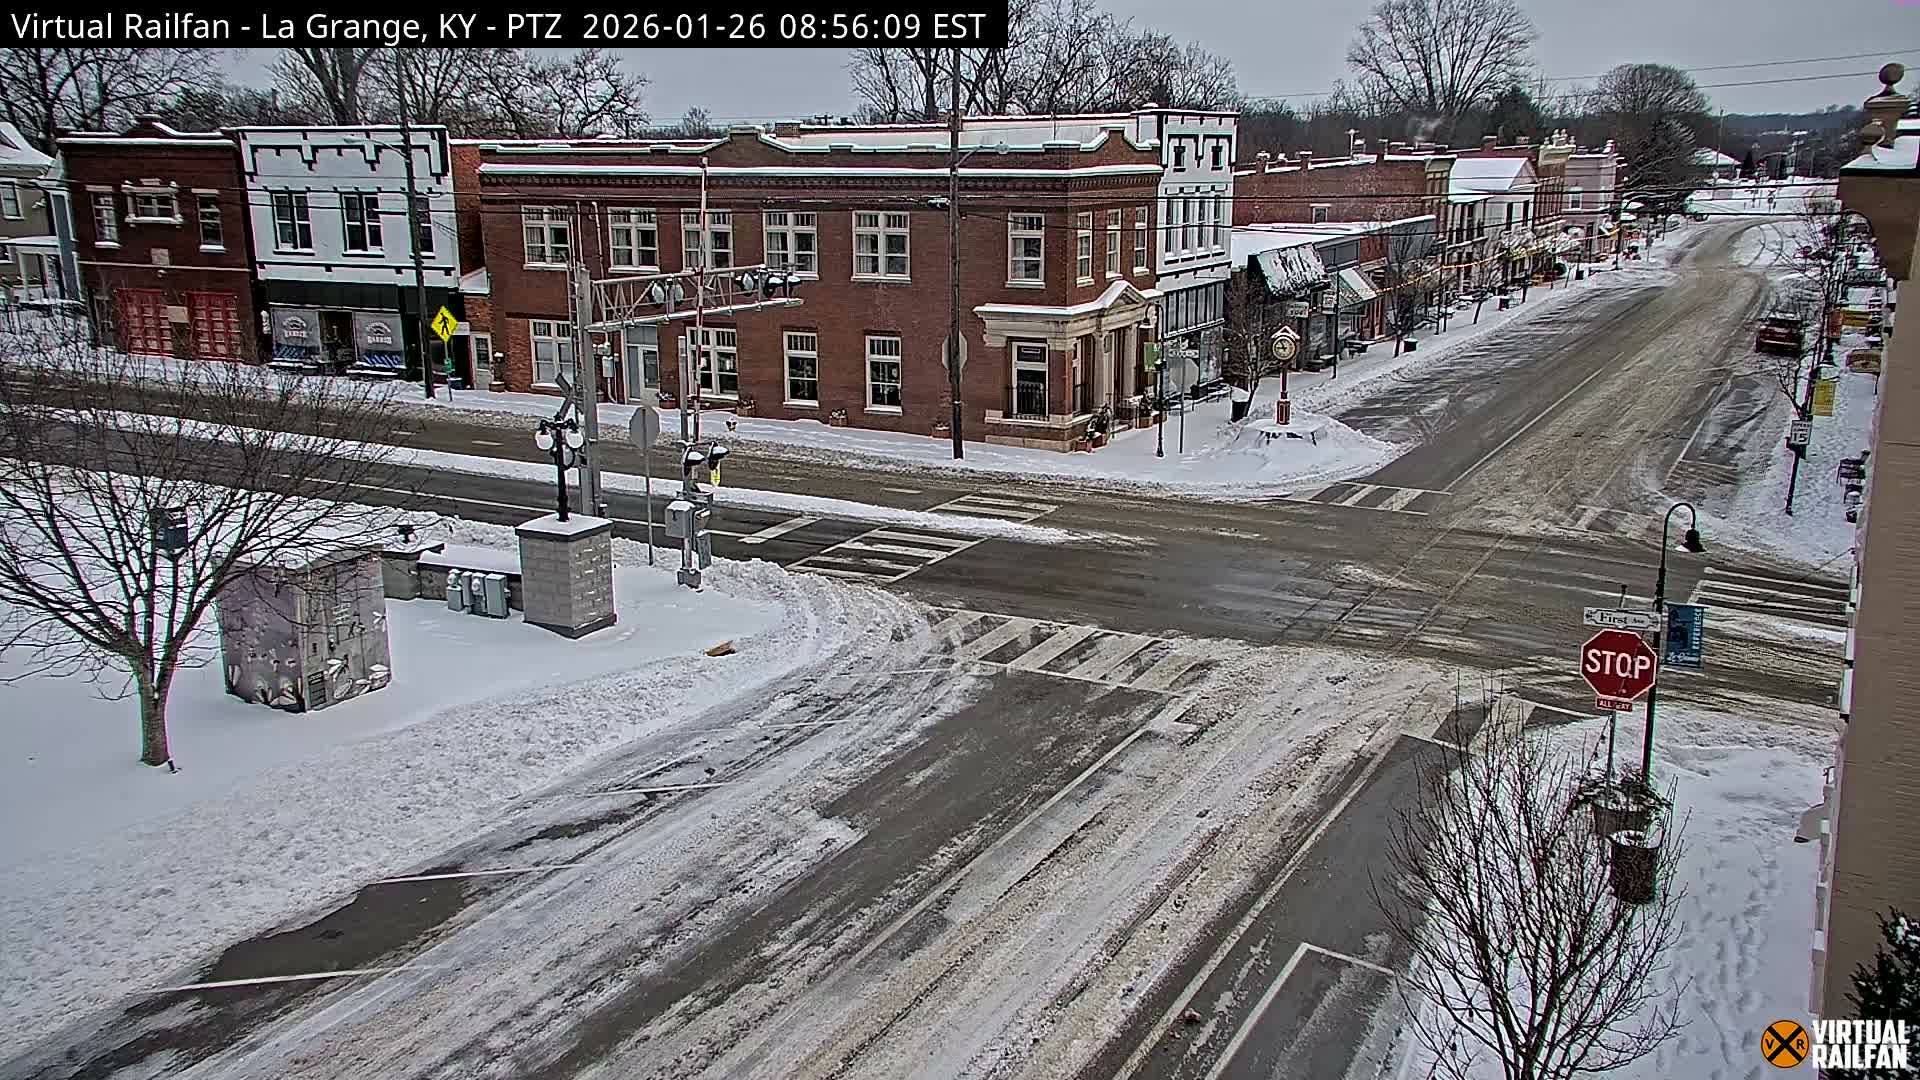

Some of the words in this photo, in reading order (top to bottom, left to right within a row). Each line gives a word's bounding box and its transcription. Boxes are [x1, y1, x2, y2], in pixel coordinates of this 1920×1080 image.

[1793, 433, 1808, 442] 15
[1600, 612, 1627, 624] First
[1585, 648, 1651, 680] STOP
[1599, 699, 1612, 708] ALL
